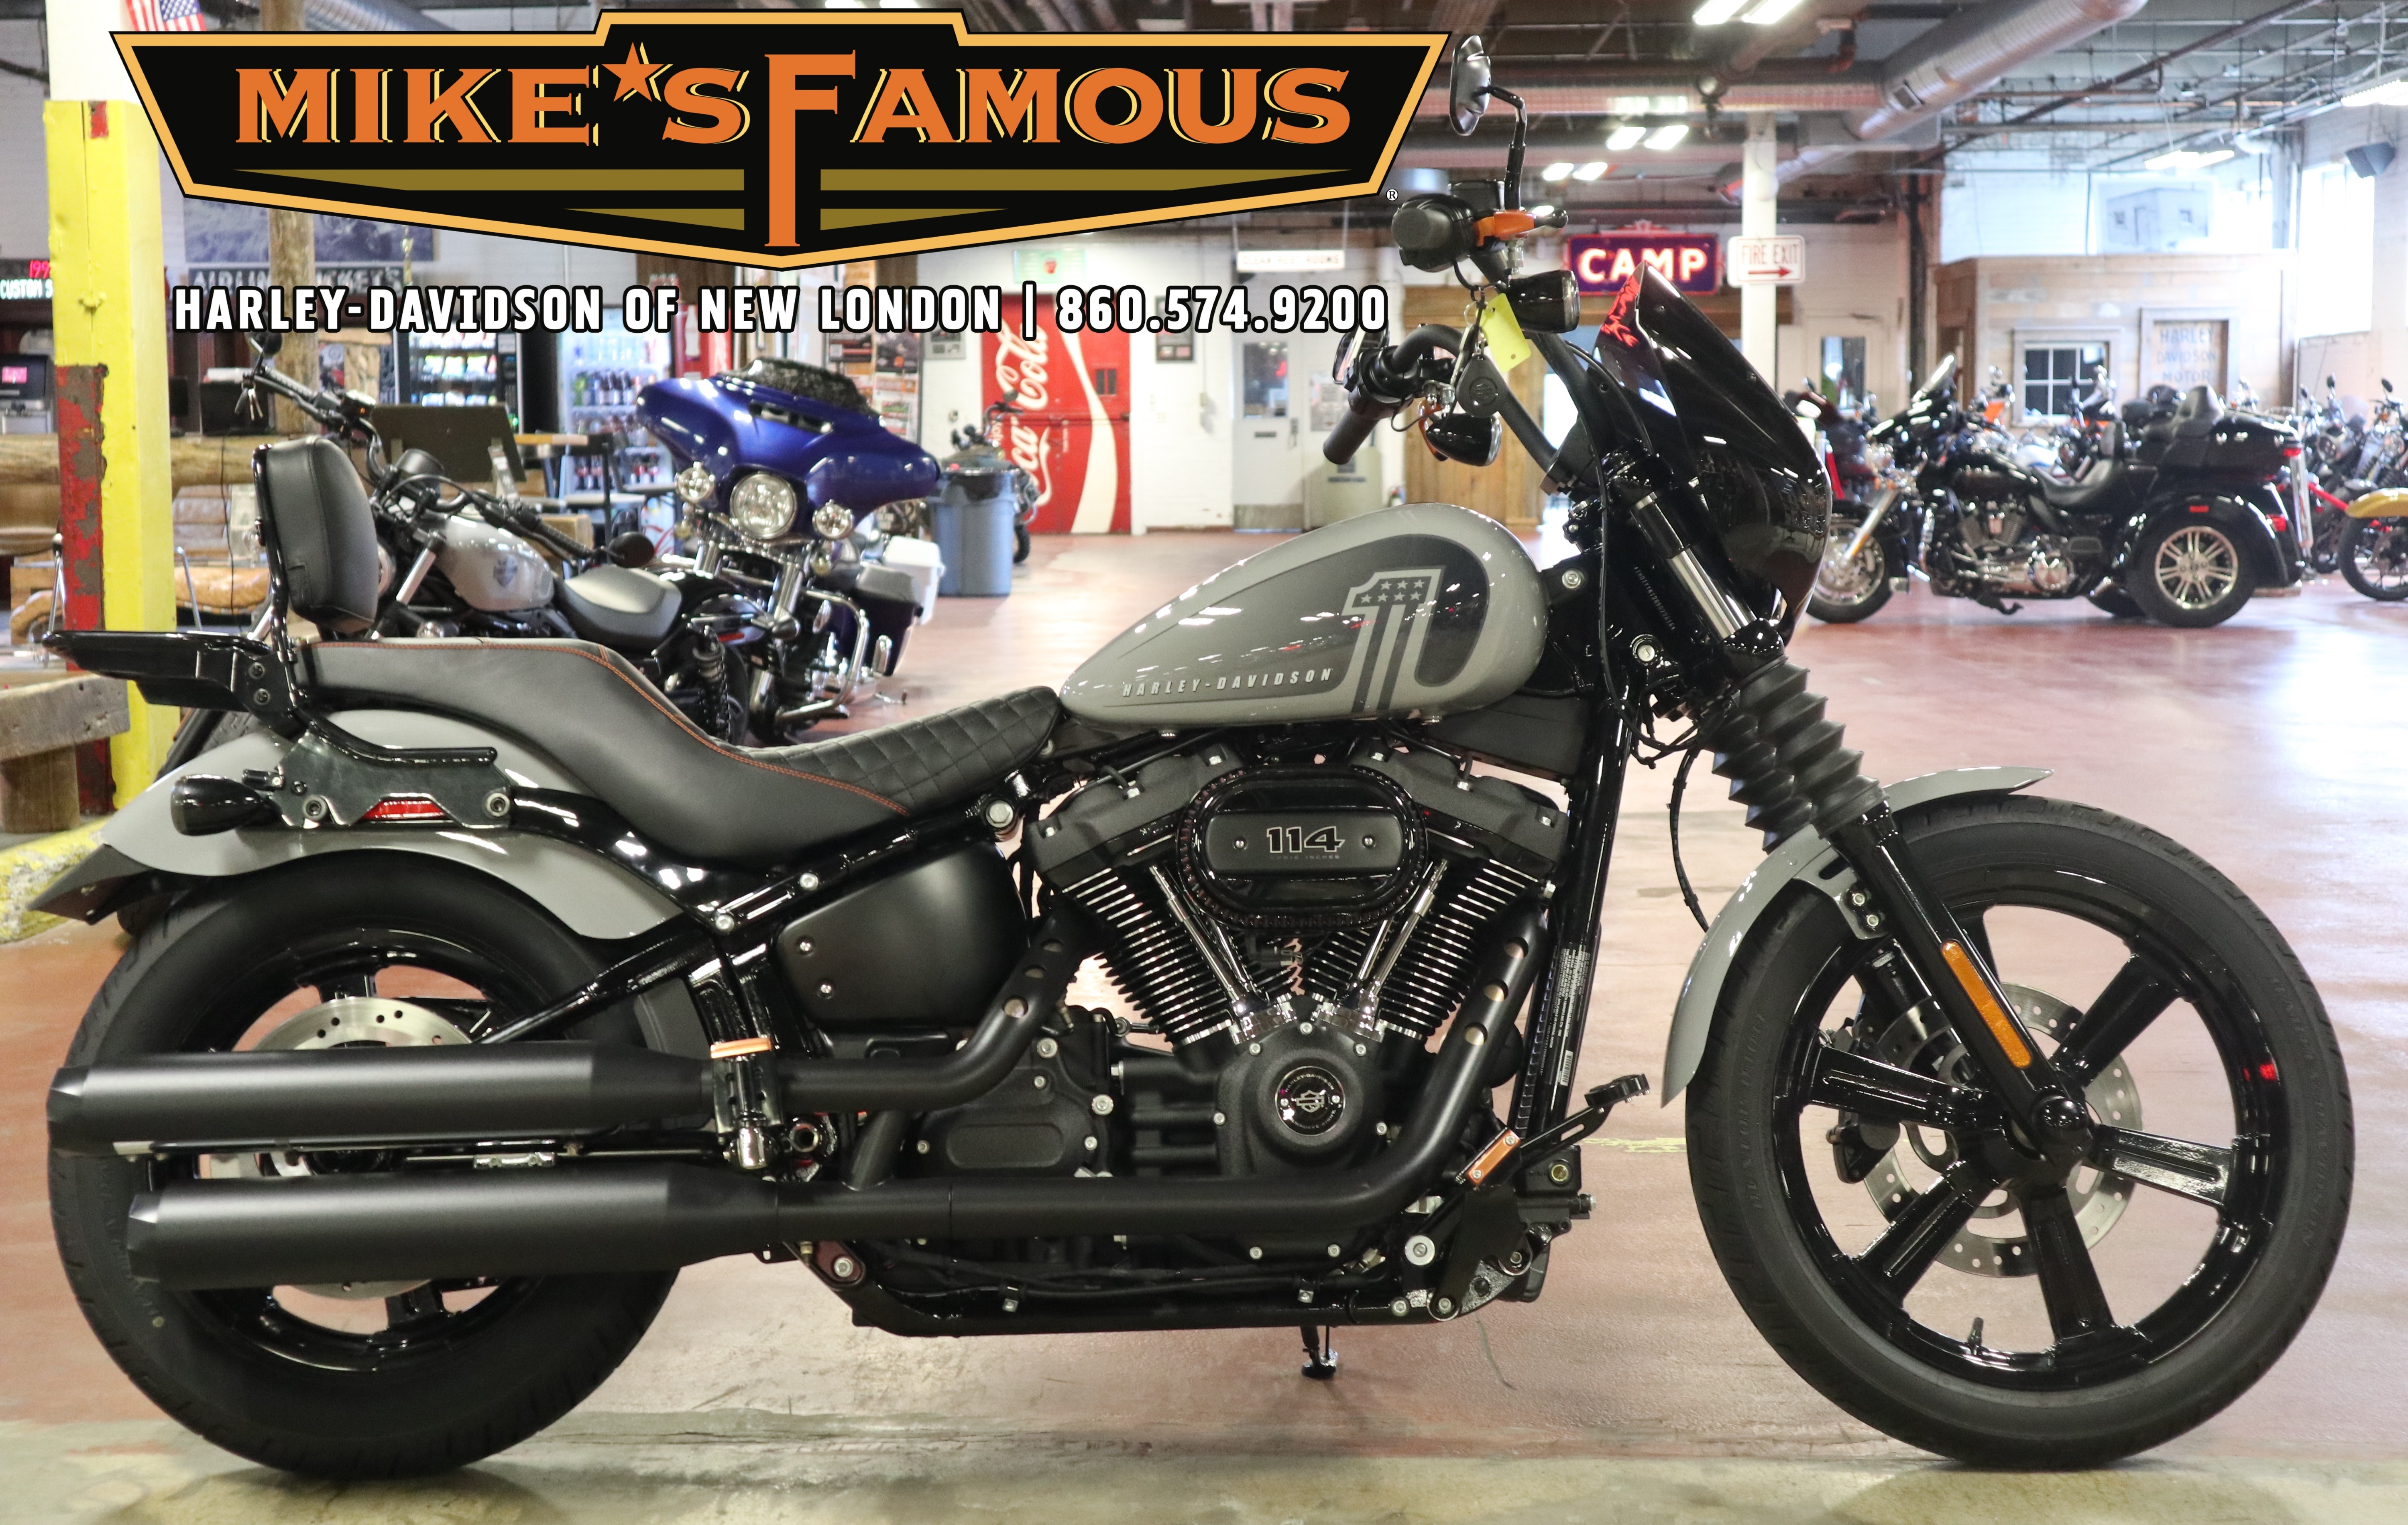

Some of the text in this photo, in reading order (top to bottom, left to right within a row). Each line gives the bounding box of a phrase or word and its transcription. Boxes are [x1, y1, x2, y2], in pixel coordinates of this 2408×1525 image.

[1578, 247, 1709, 284] CAMP
[1741, 244, 1799, 264] FIRE EXIT
[0, 279, 42, 300] CUSTOM
[1122, 667, 1334, 697] HARLEY-DAVIDSON
[1266, 826, 1346, 853] 114
